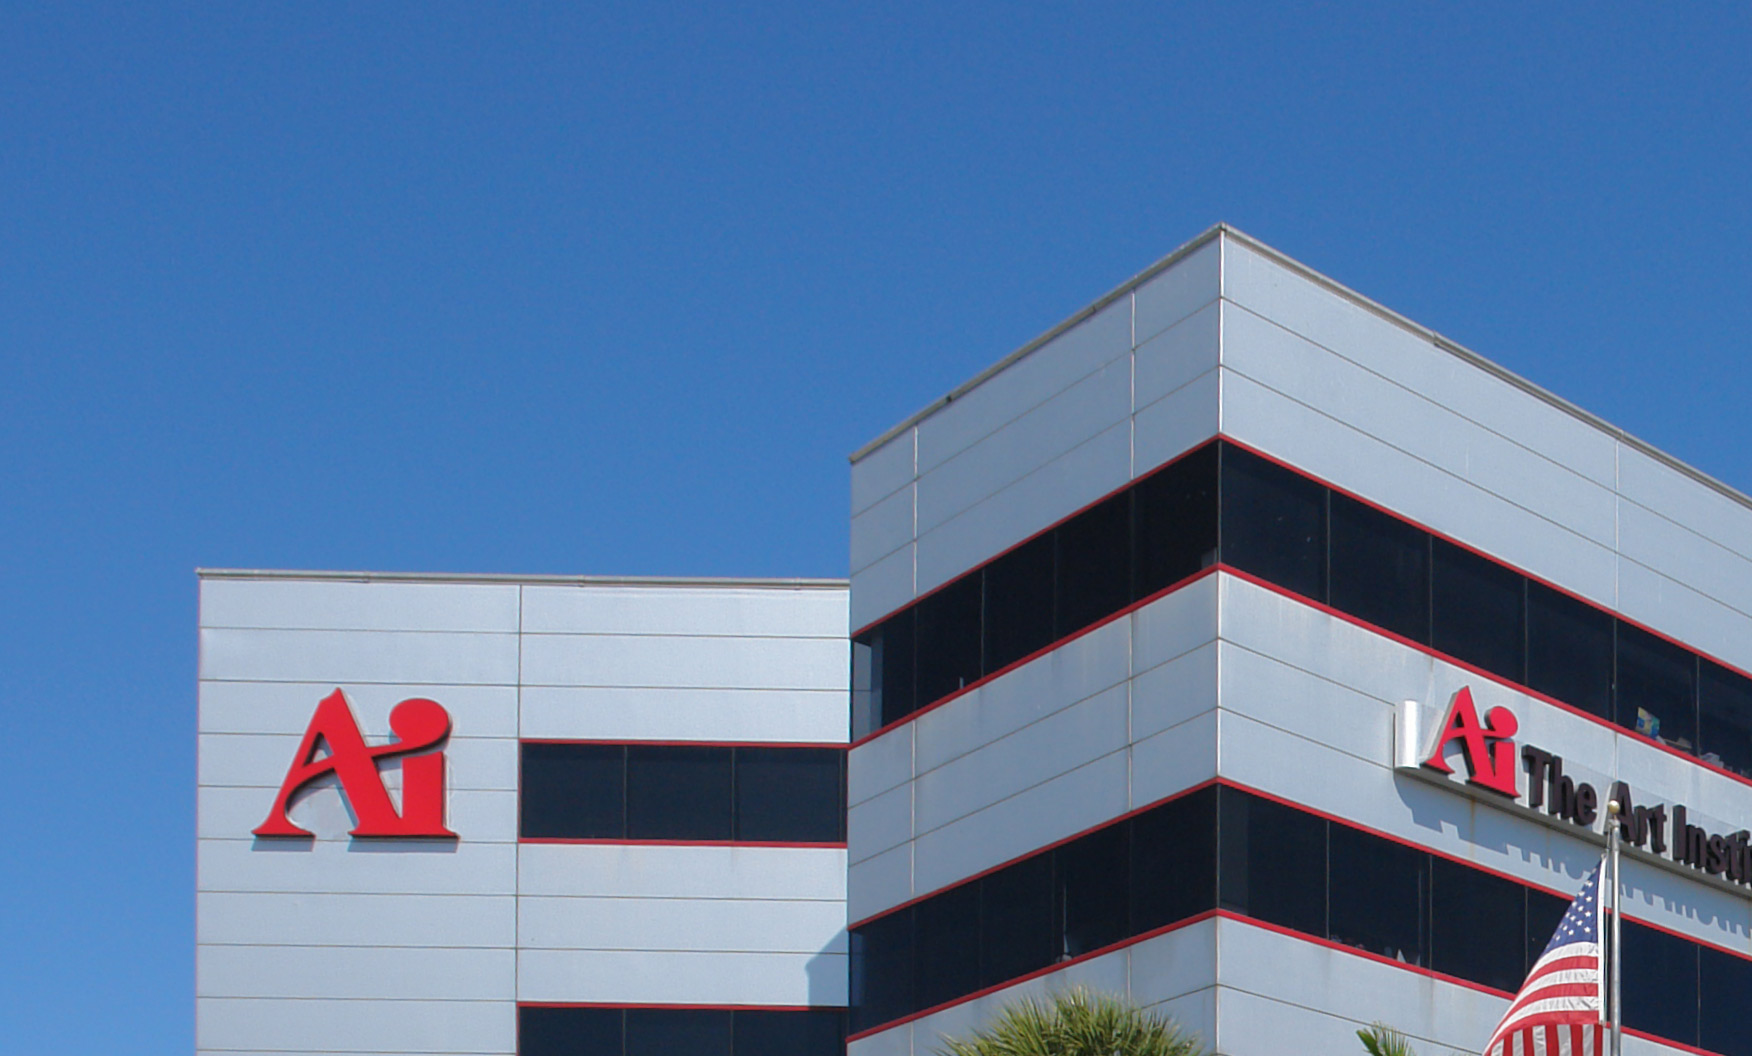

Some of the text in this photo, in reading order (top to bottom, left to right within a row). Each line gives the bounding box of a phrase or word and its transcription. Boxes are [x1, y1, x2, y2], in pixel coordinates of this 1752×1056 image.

[252, 687, 460, 840] Ai
[1420, 685, 1521, 799] Ai
[1521, 744, 1597, 826] The
[1603, 780, 1667, 854] Art
